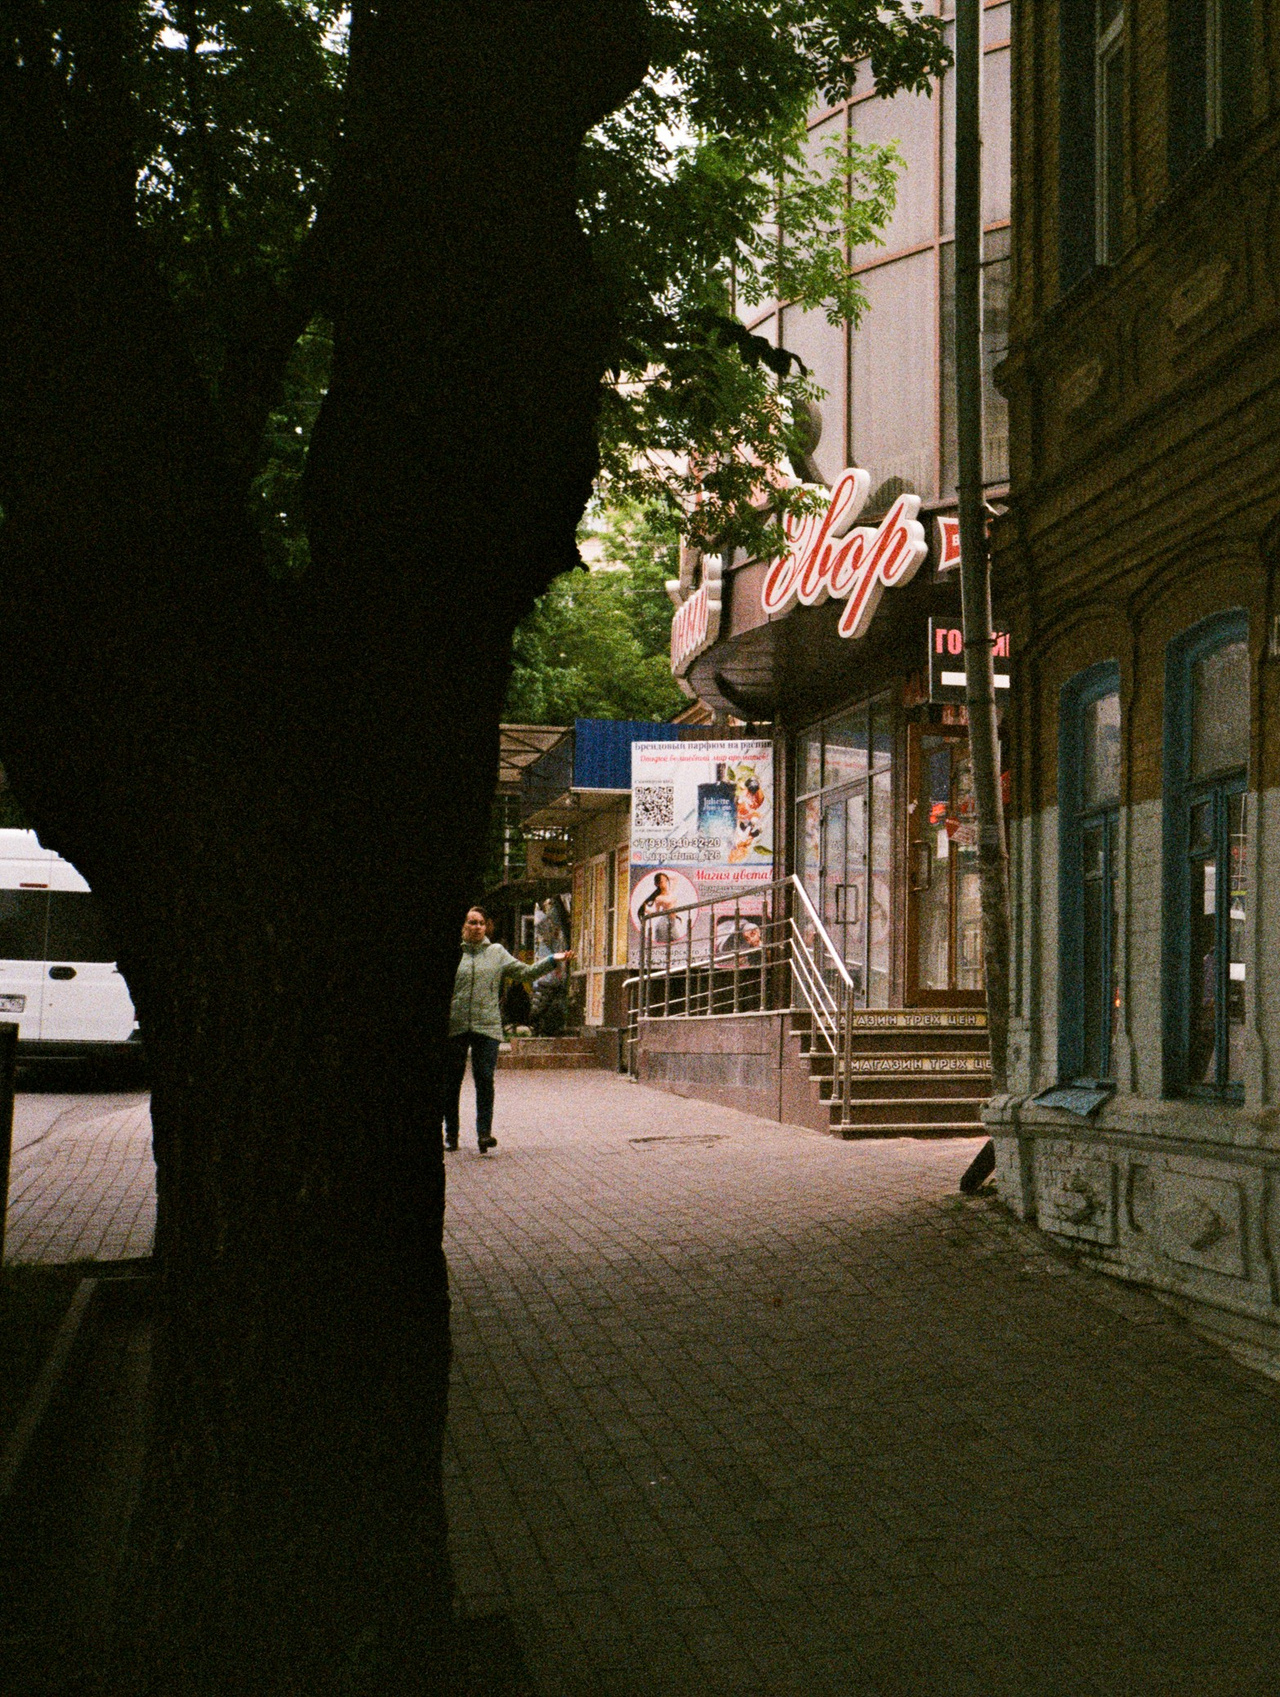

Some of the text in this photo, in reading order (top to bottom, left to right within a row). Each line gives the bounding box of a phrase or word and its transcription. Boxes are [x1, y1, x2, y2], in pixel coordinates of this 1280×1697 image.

[695, 869, 730, 880] Магия
[904, 1014, 942, 1025] ТРЕХ
[948, 1014, 978, 1025] ЦЕН
[850, 1058, 992, 1070] МАГАЗИН ТРЕХ ЦЕ
